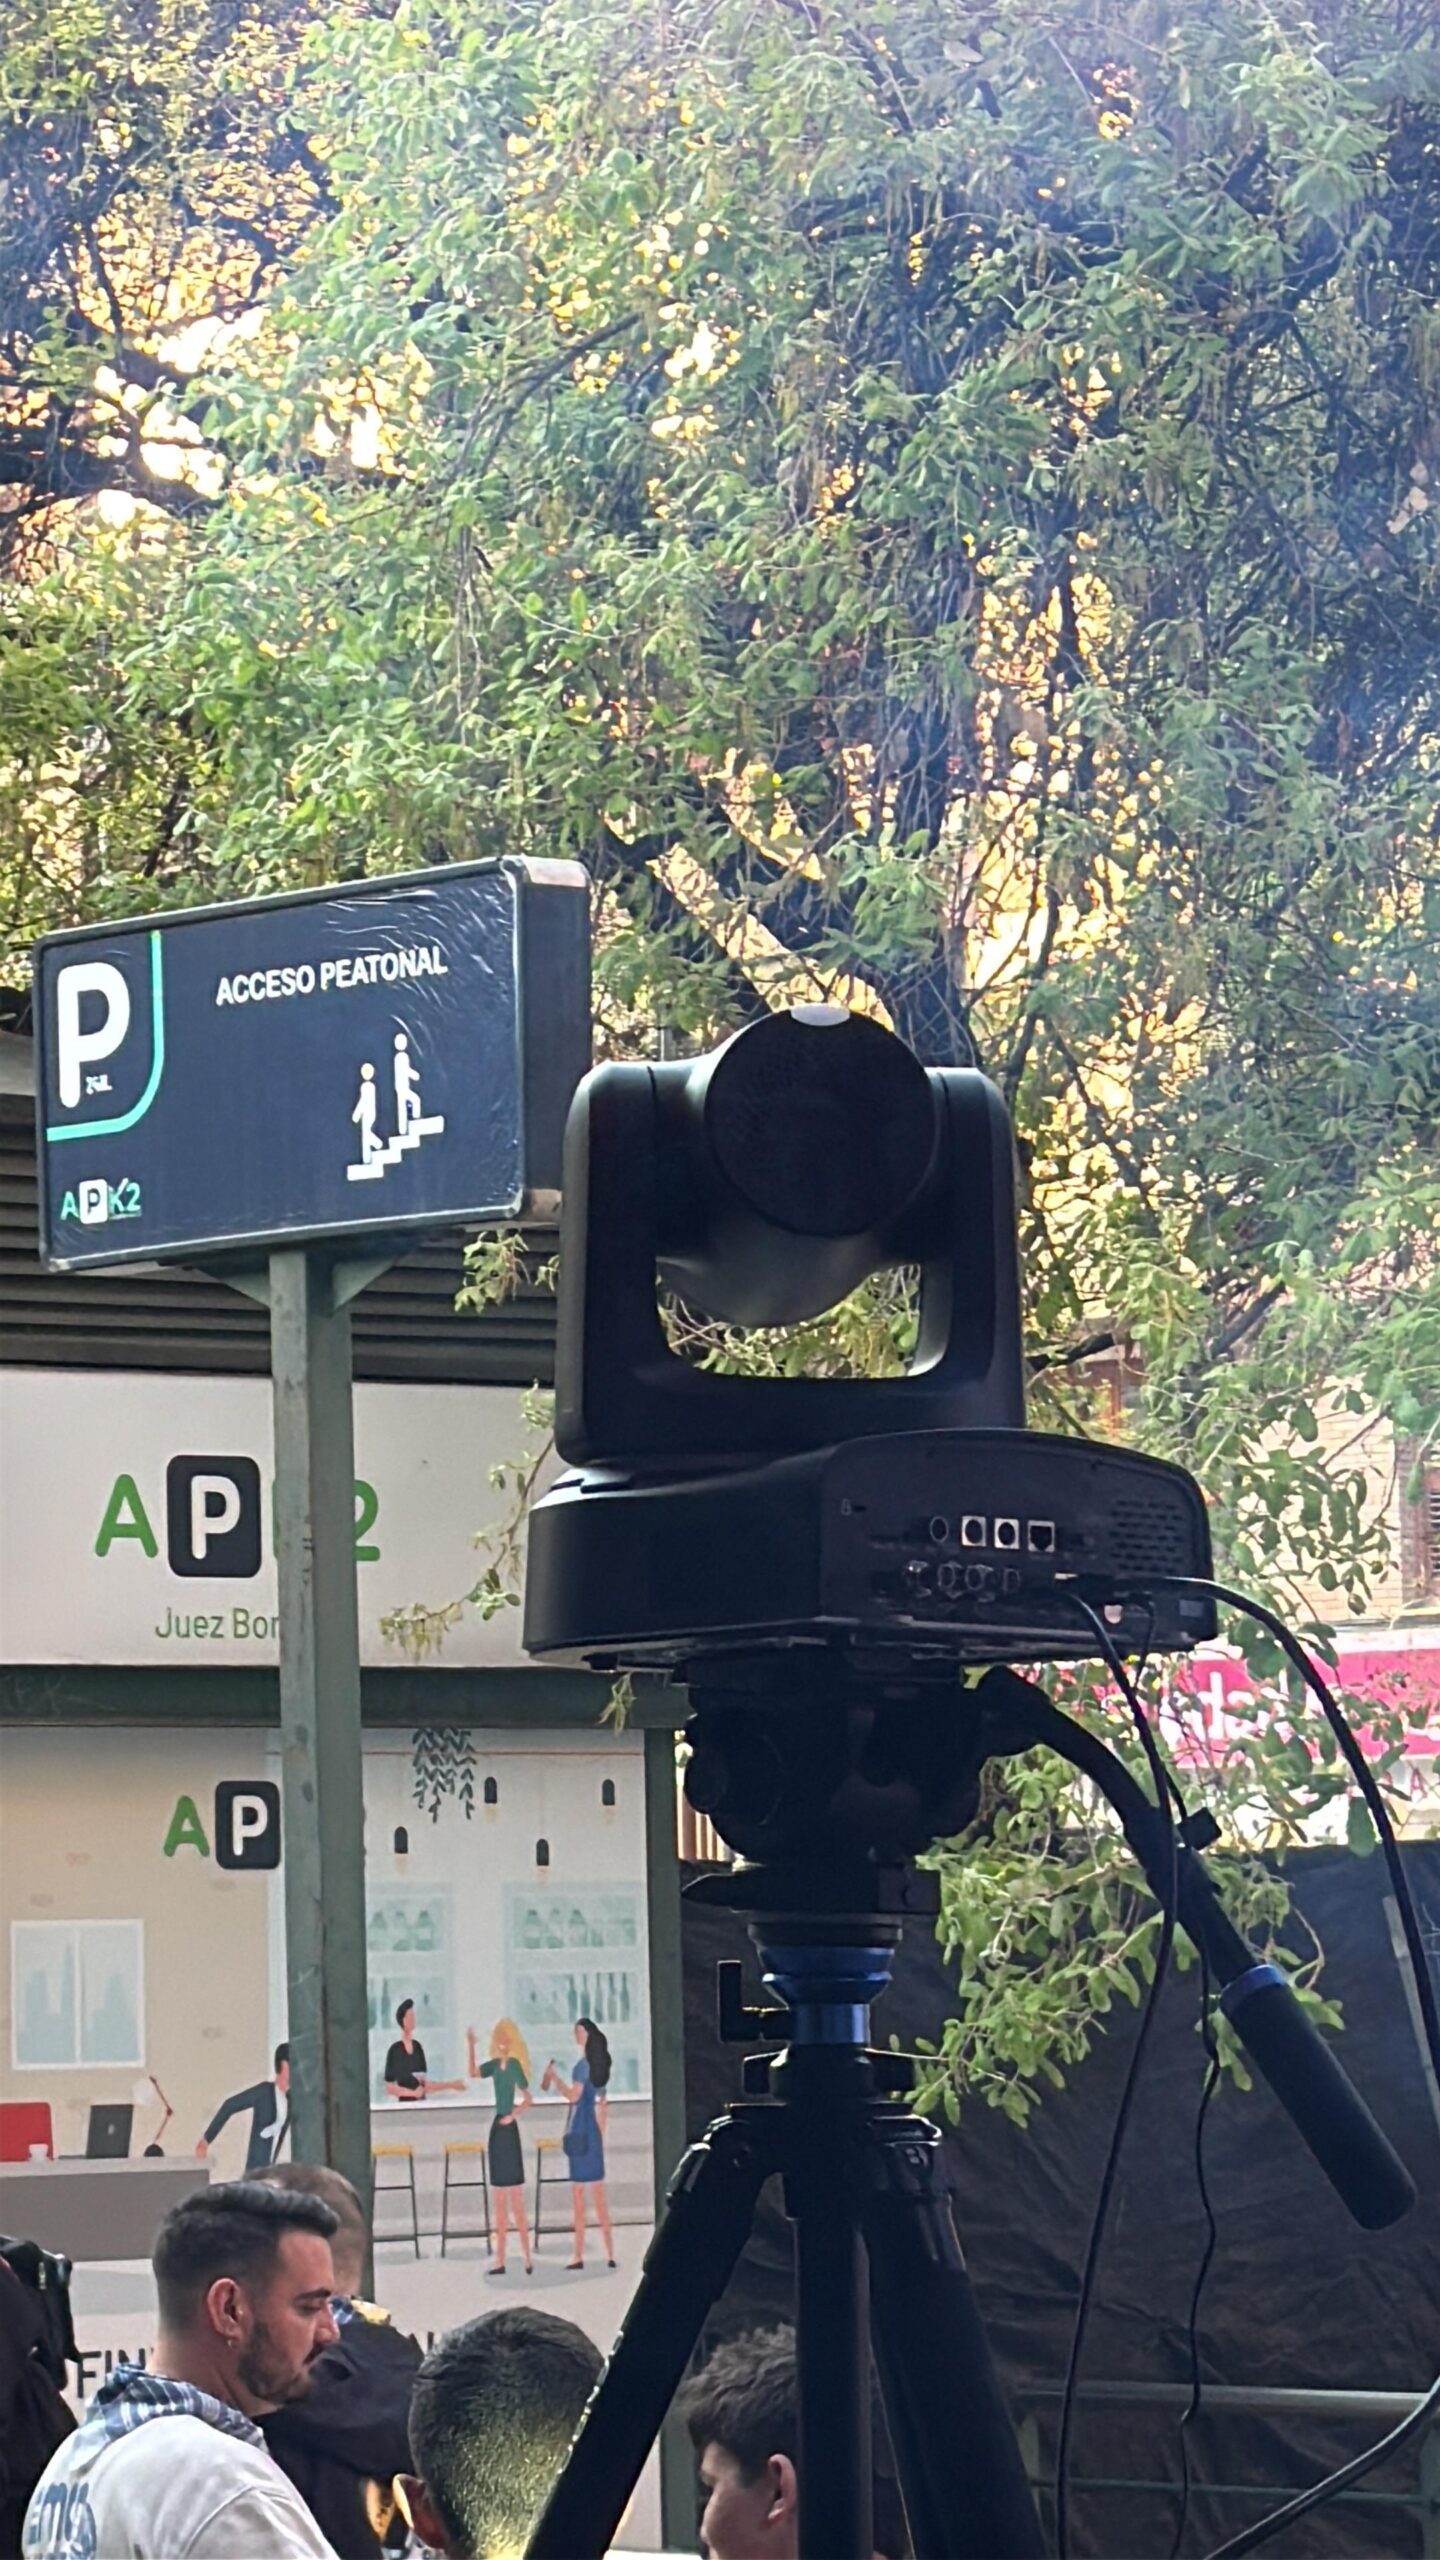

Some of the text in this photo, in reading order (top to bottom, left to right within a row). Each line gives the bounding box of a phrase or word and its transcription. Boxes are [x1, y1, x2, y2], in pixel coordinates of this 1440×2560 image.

[216, 946, 449, 1006] ACCESO PEATONAL
[57, 962, 130, 1108] P
[60, 1178, 142, 1224] APK2
[94, 1473, 381, 1562] AP2
[155, 1606, 224, 1639] Juez
